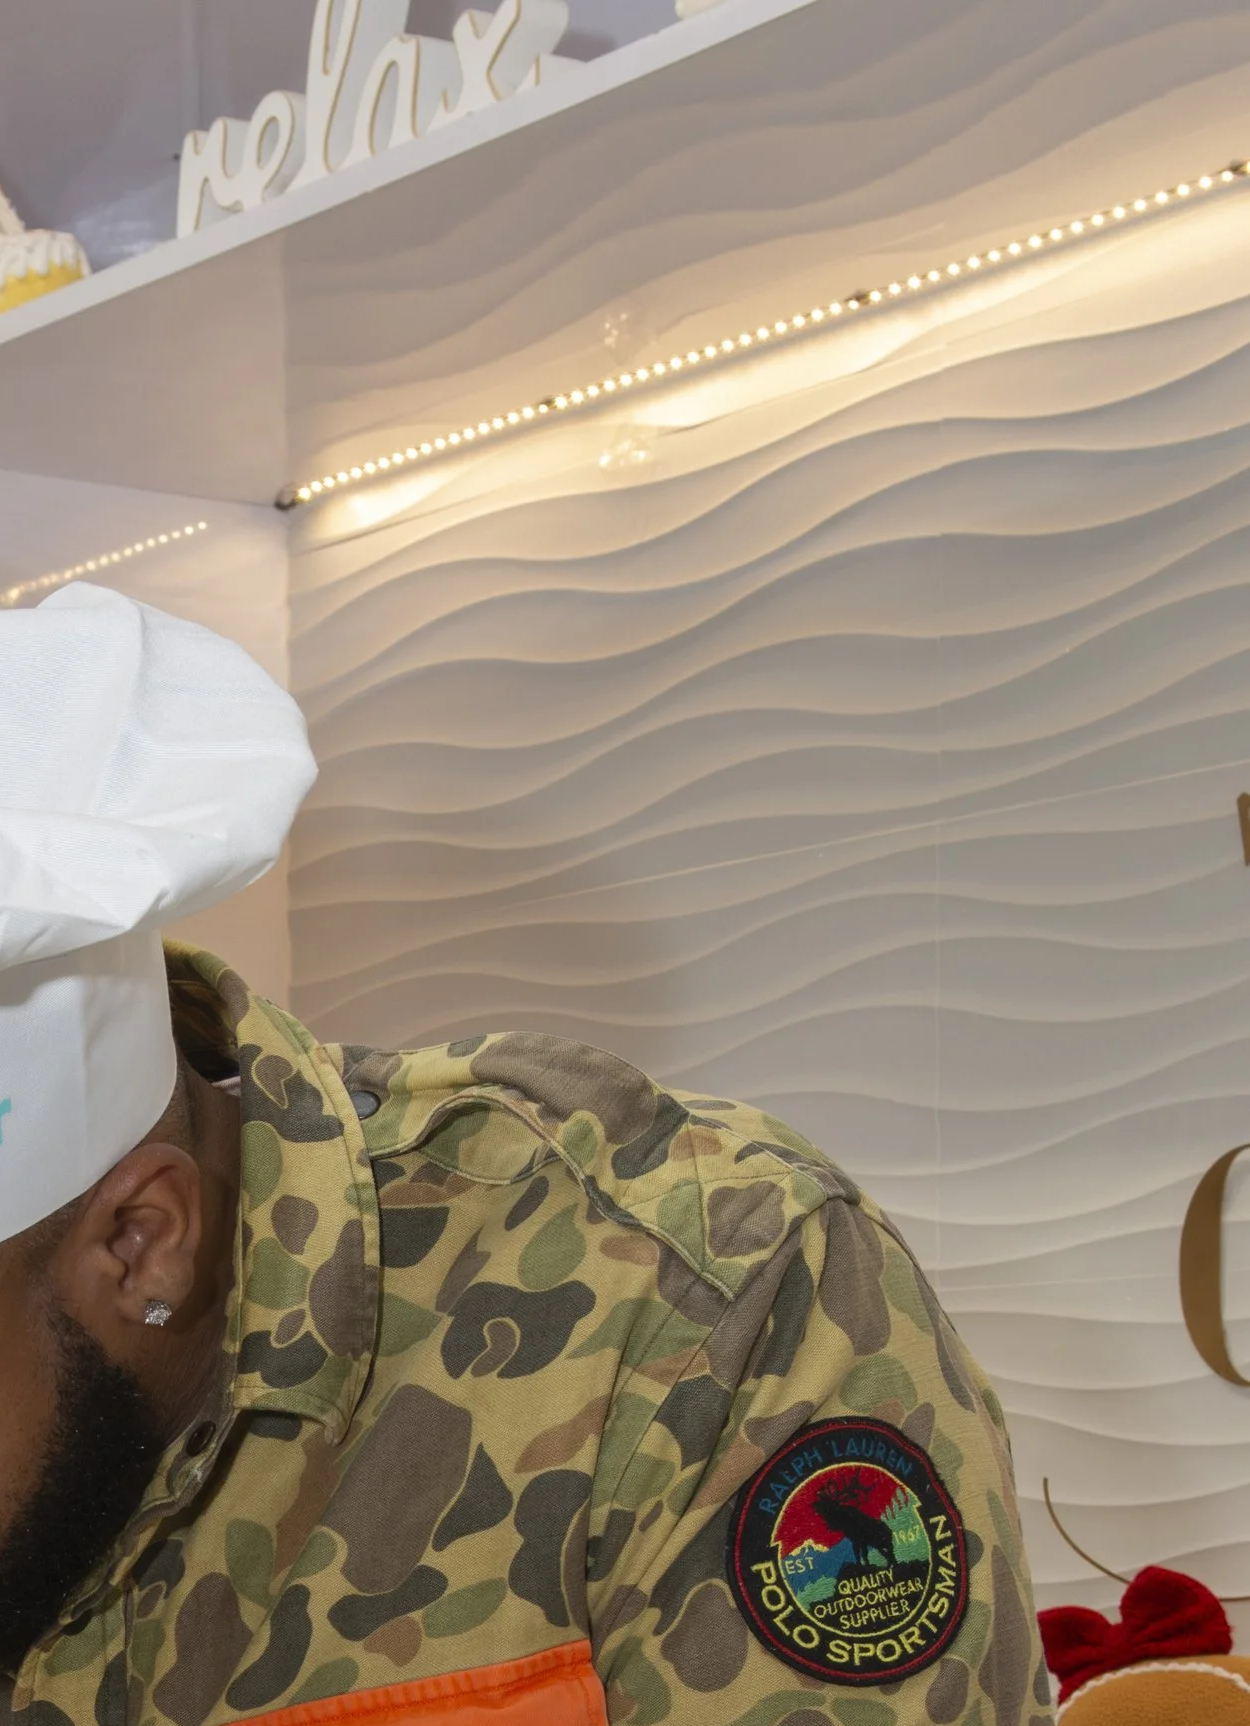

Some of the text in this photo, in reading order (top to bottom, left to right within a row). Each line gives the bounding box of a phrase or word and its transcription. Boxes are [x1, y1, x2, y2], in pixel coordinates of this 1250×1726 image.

[759, 1438, 913, 1515] RALPH LAUREN
[785, 1556, 814, 1575] EST
[838, 1569, 894, 1595] QUALITY
[750, 1514, 957, 1666] POLO SPORTSMAN
[814, 1577, 924, 1618] OUTDOORWEAR
[839, 1599, 911, 1630] SUPPLIER
